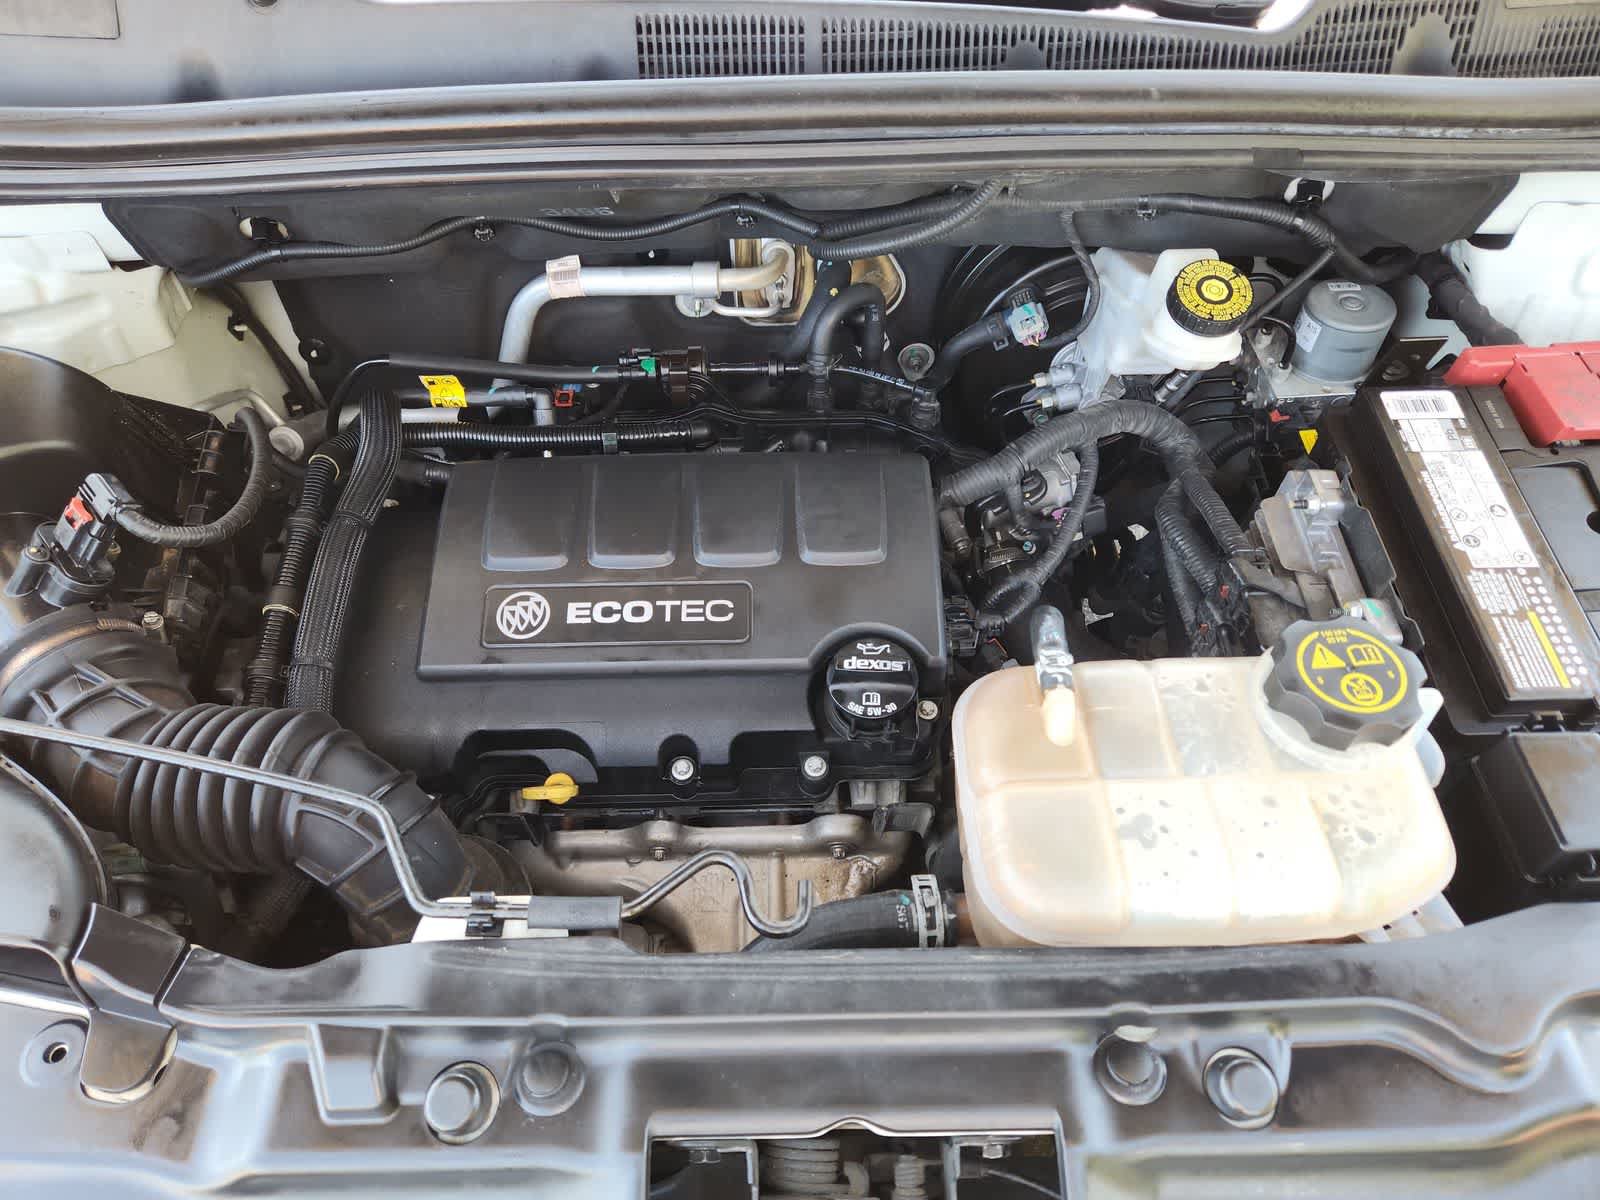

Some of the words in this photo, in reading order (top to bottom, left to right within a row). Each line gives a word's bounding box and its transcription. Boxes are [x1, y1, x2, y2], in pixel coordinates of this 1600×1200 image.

[566, 600, 735, 624] ECOTEC
[843, 656, 906, 672] dexos
[847, 701, 865, 715] SAE
[867, 702, 898, 716] 5W-30
